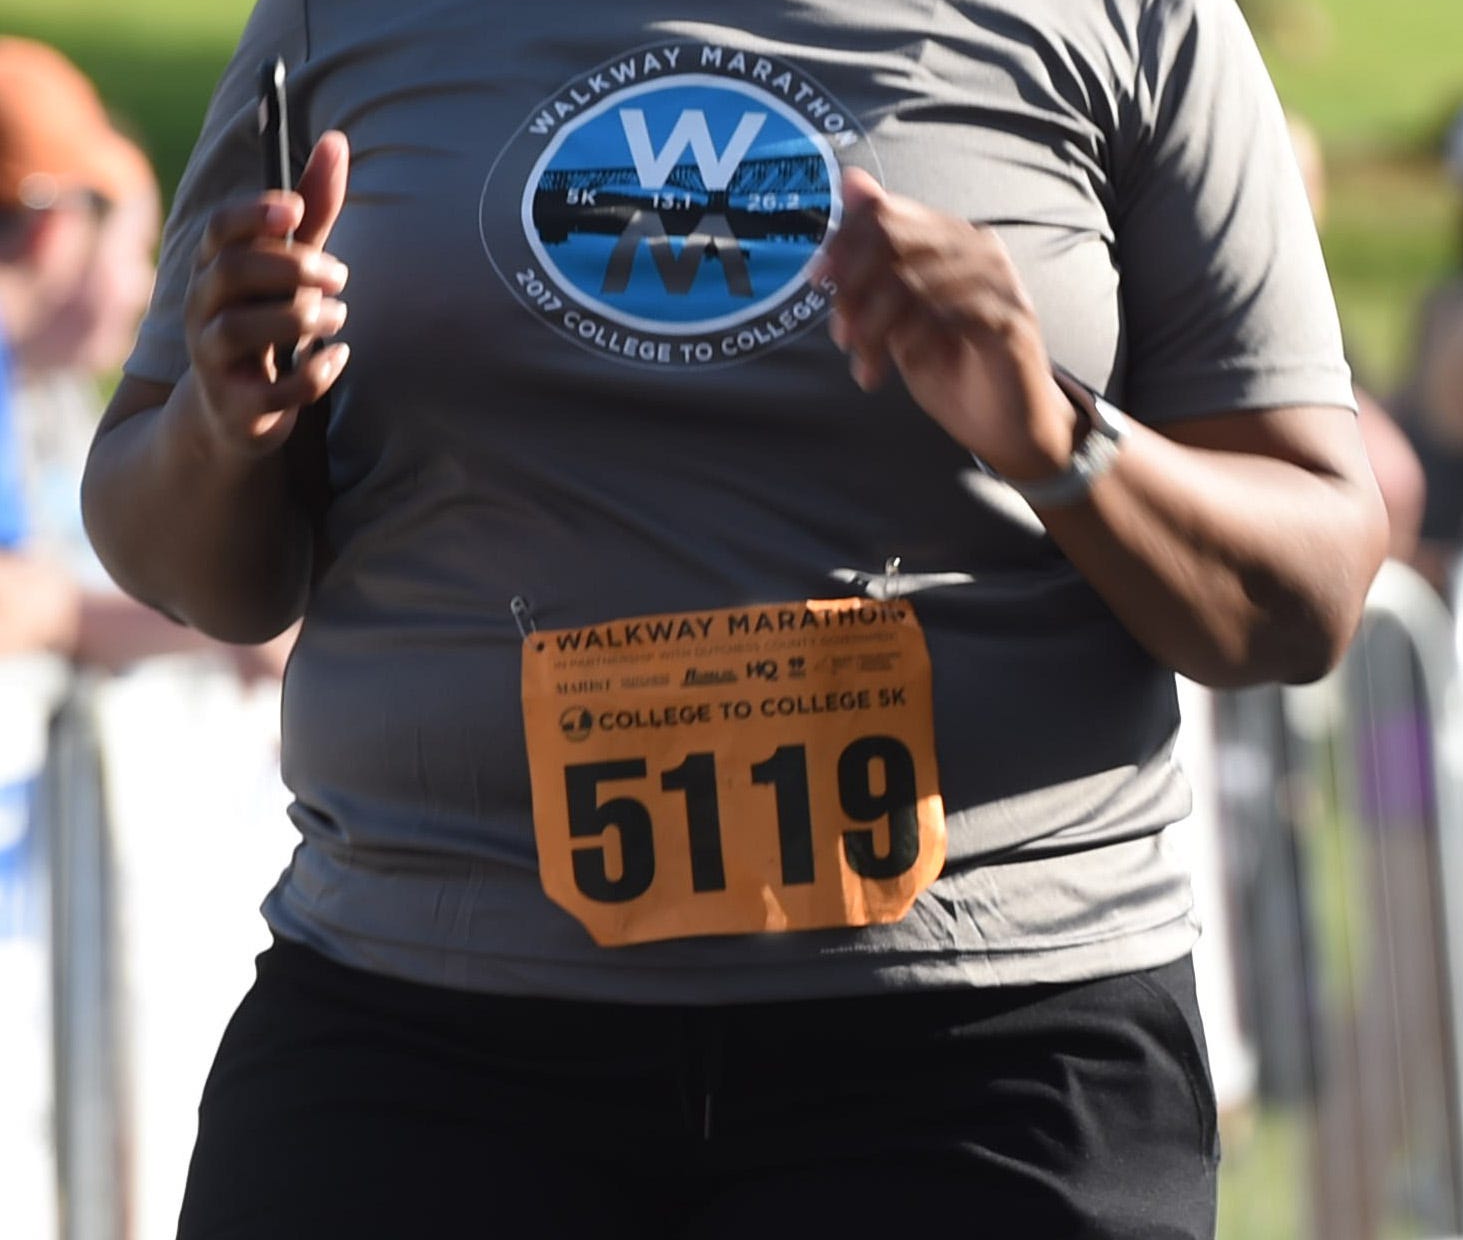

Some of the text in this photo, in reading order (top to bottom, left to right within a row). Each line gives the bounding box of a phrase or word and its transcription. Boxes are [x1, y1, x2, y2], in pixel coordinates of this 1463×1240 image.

[530, 46, 858, 147] WALKWAY MARATHON
[619, 108, 767, 191] W
[566, 188, 801, 212] 5K 13.1 26.2
[516, 269, 563, 311] 2017
[563, 311, 671, 364] COLLEGE
[679, 343, 714, 364] TO
[721, 291, 826, 357] COLLEGE
[555, 617, 715, 653] WALKWAY
[745, 658, 779, 682] HQ
[600, 686, 907, 732] COLLEGE TO COLLEGE 5K
[563, 734, 921, 904] 5119
